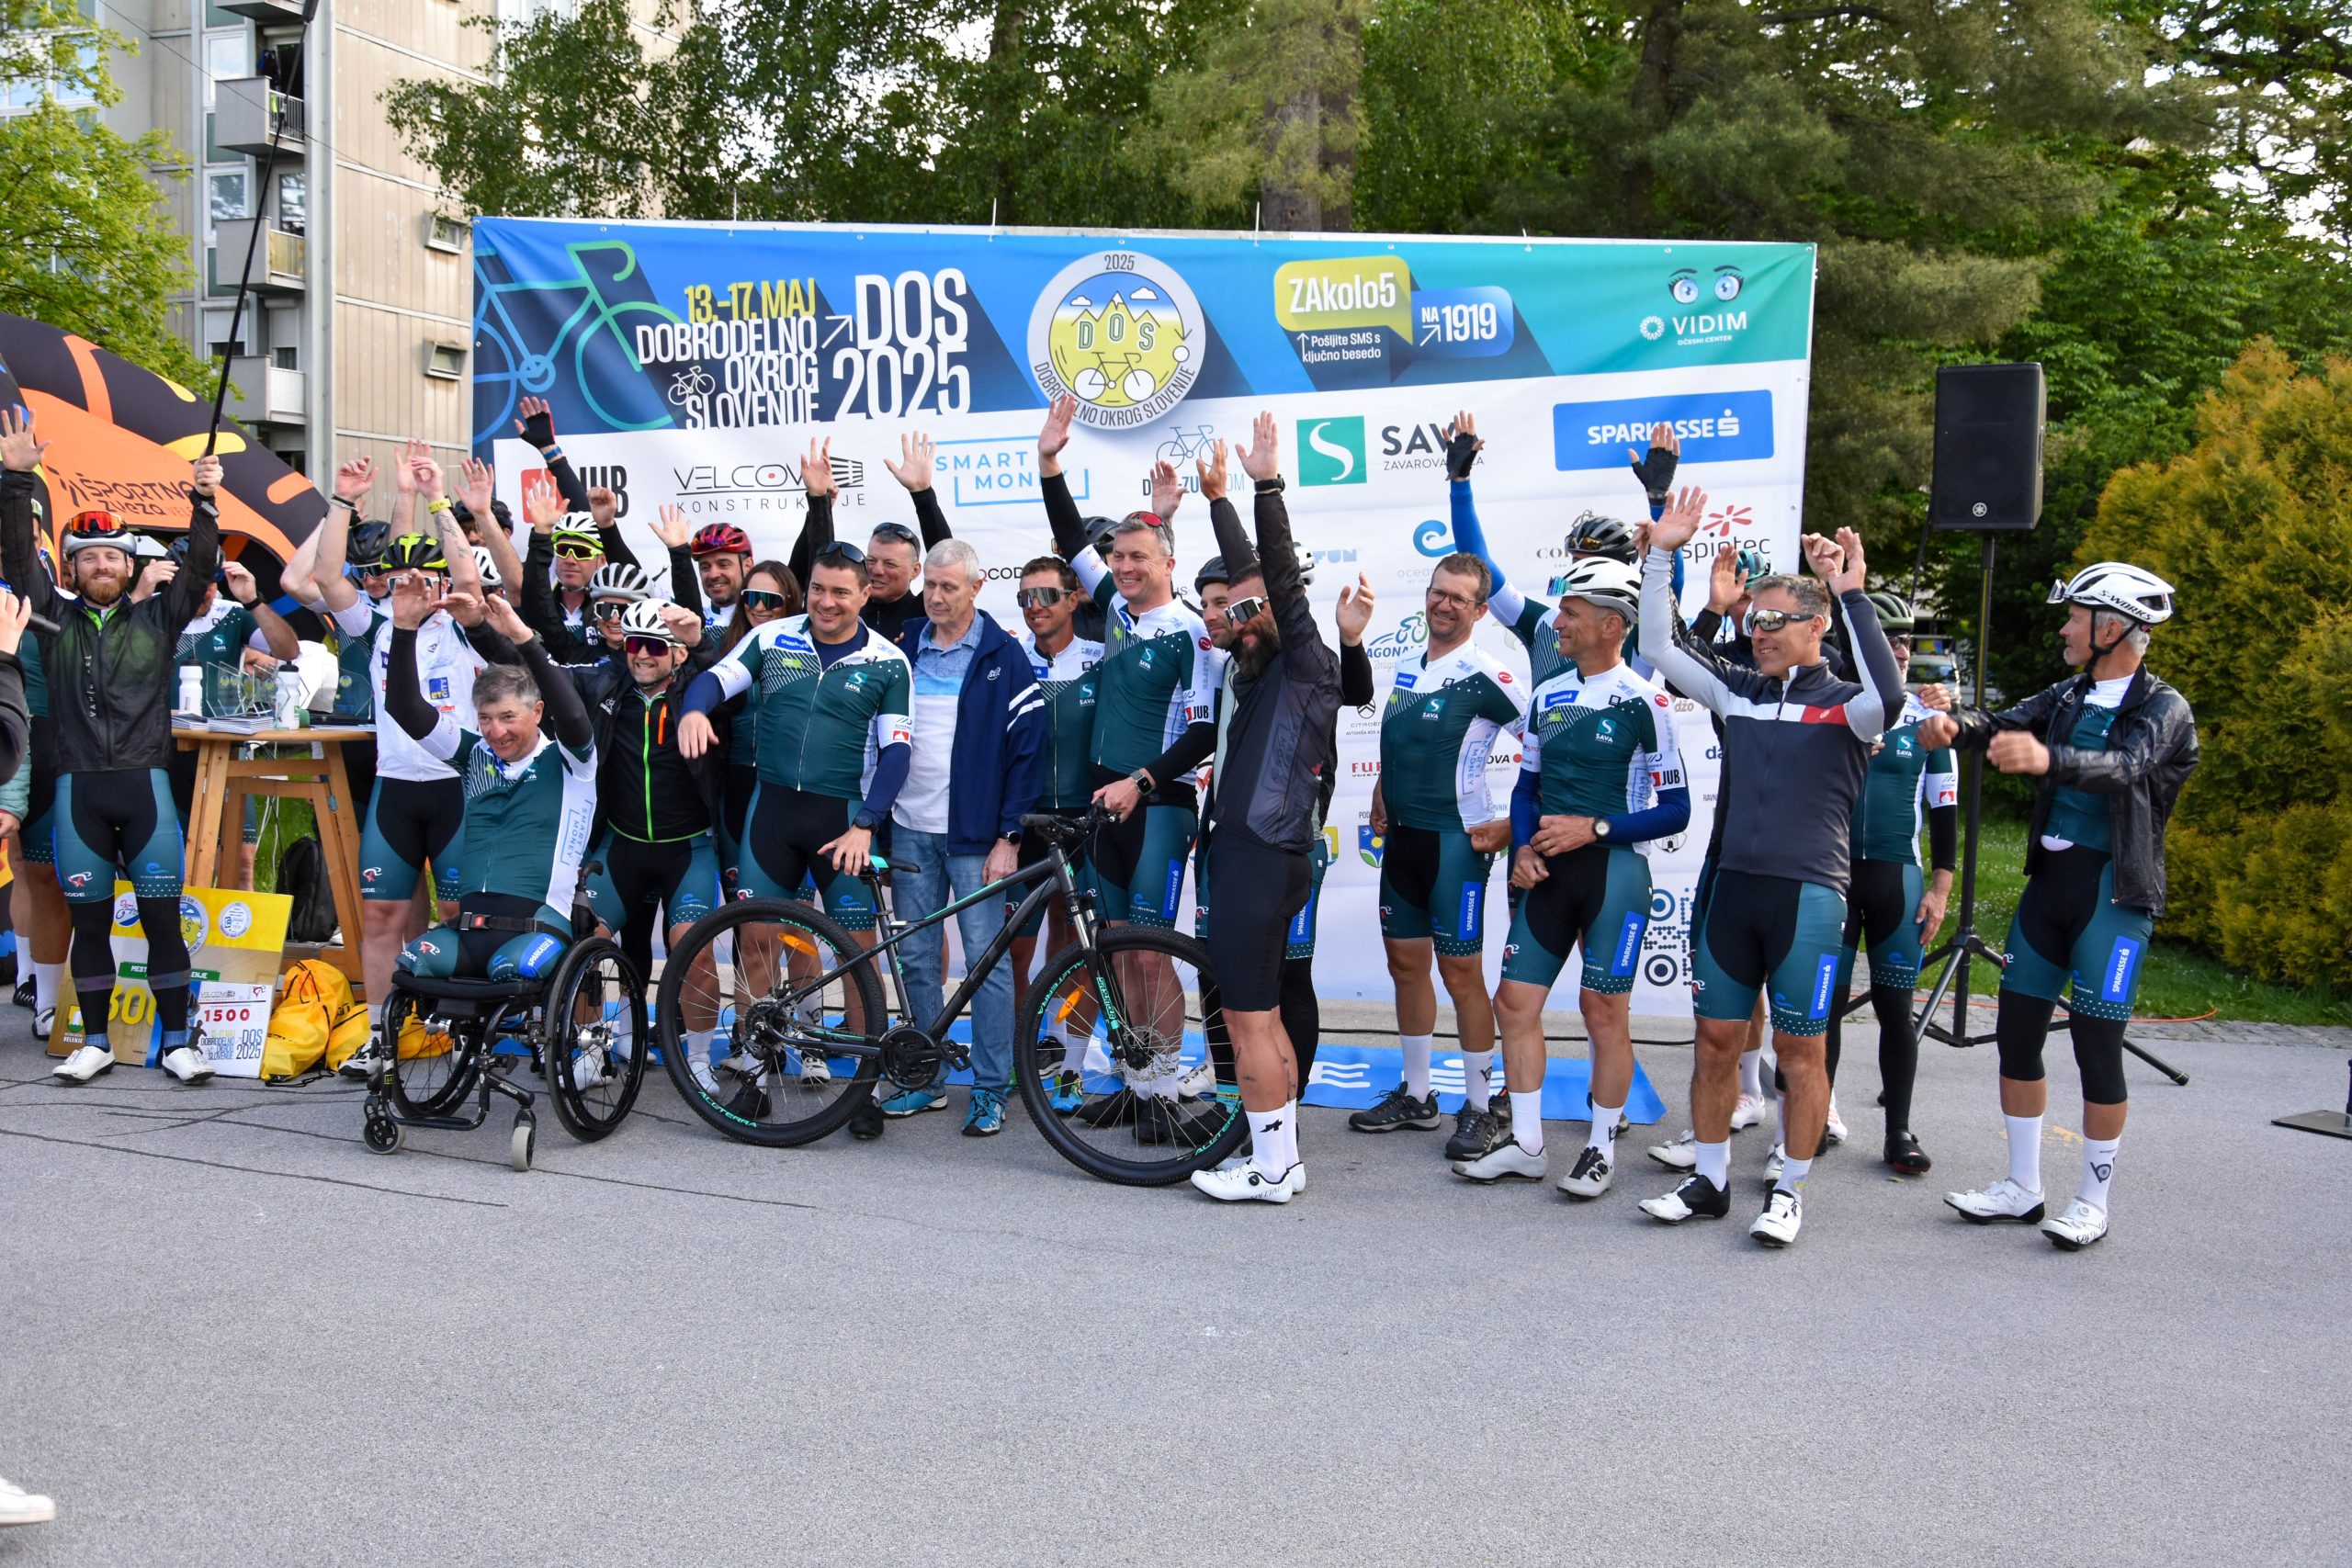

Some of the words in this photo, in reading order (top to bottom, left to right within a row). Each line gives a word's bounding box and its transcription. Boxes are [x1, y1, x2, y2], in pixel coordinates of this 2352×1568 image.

[1104, 254, 1135, 270] 2025
[761, 277, 816, 320] MAJ
[1288, 272, 1396, 313] ZAkolo5
[854, 267, 968, 350] DOS
[1421, 306, 1440, 323] NA
[1442, 302, 1498, 343] 1919
[1672, 311, 1747, 335] VIDIM
[636, 316, 818, 365] DOBRODELNO
[1311, 334, 1348, 348] Pošljite
[1351, 333, 1372, 344] SMS
[1705, 334, 1733, 343] CENTER
[1302, 349, 1340, 364] ključno
[1342, 347, 1381, 360] besedo
[725, 352, 819, 395] OKROG
[832, 341, 971, 422] 2025
[1035, 362, 1097, 423] DOBROLNO
[1100, 407, 1143, 426] OKROG
[1143, 366, 1195, 418] SLOVENIJE
[1382, 422, 1483, 456] SAV
[936, 451, 1028, 471] SMART
[975, 468, 1069, 491] MON
[677, 493, 865, 514] KONSTRUKJE
[2098, 590, 2154, 621] S-WORKS
[844, 682, 861, 692] SAVA
[1193, 705, 1209, 719] JUB
[1596, 733, 1613, 743] SAVA
[1662, 770, 1680, 786] JUB
[1467, 897, 1476, 931] SPARKASSE
[528, 942, 550, 966] SPARKASSE
[1622, 931, 1635, 966] SPARKASSE
[2112, 956, 2128, 993] SPARKASSE
[1818, 972, 1830, 1010] SPARKASSE
[204, 1008, 250, 1021] 1500
[243, 1029, 263, 1044] DOS
[236, 1043, 261, 1059] 2025
